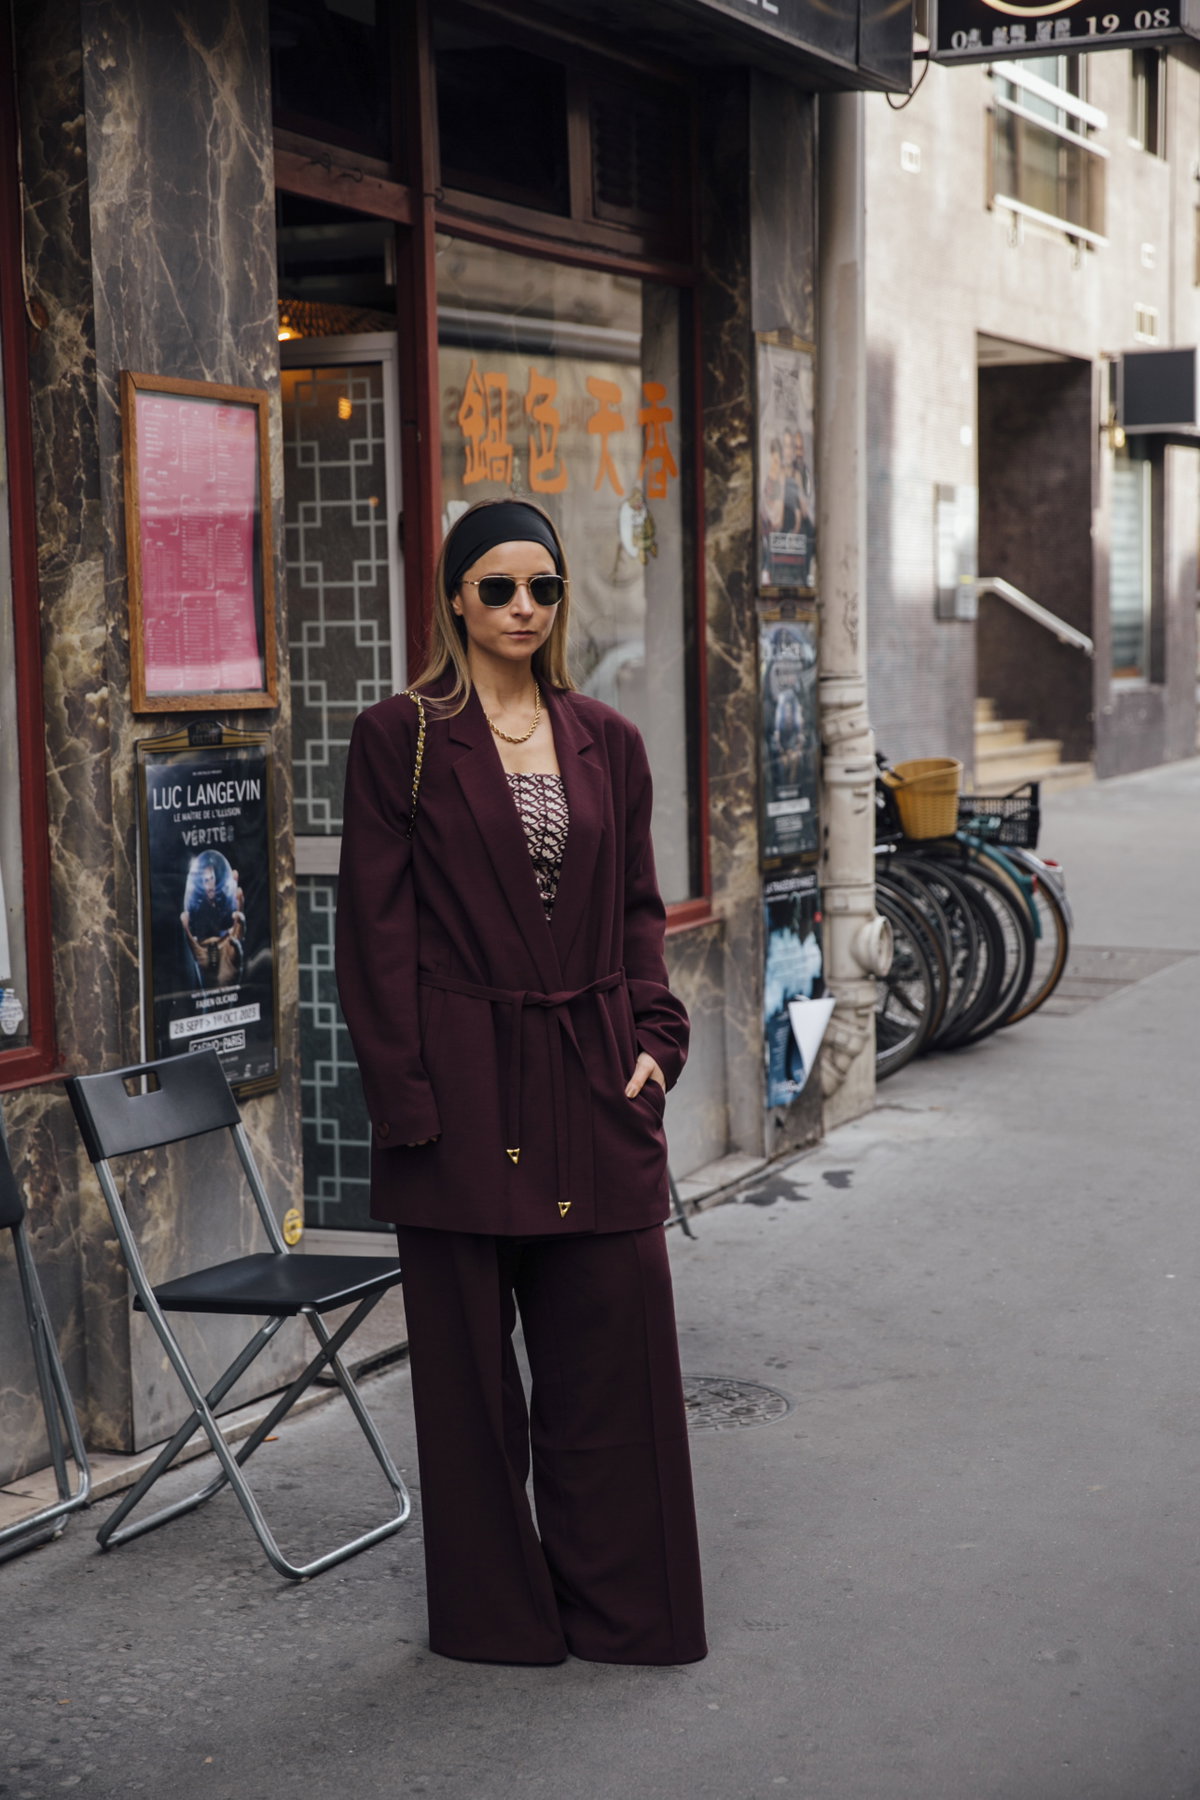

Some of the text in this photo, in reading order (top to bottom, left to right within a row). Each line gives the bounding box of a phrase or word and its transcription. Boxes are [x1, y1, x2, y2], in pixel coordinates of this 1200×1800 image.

[951, 28, 982, 49] 0
[1086, 14, 1120, 36] 19
[1134, 8, 1170, 31] 08
[153, 779, 260, 811] LUC LANGEVIN
[173, 812, 181, 823] LE
[203, 809, 211, 820] DE
[174, 1022, 184, 1035] 28
[186, 1018, 203, 1032] SEPT
[240, 1007, 257, 1021] 2023
